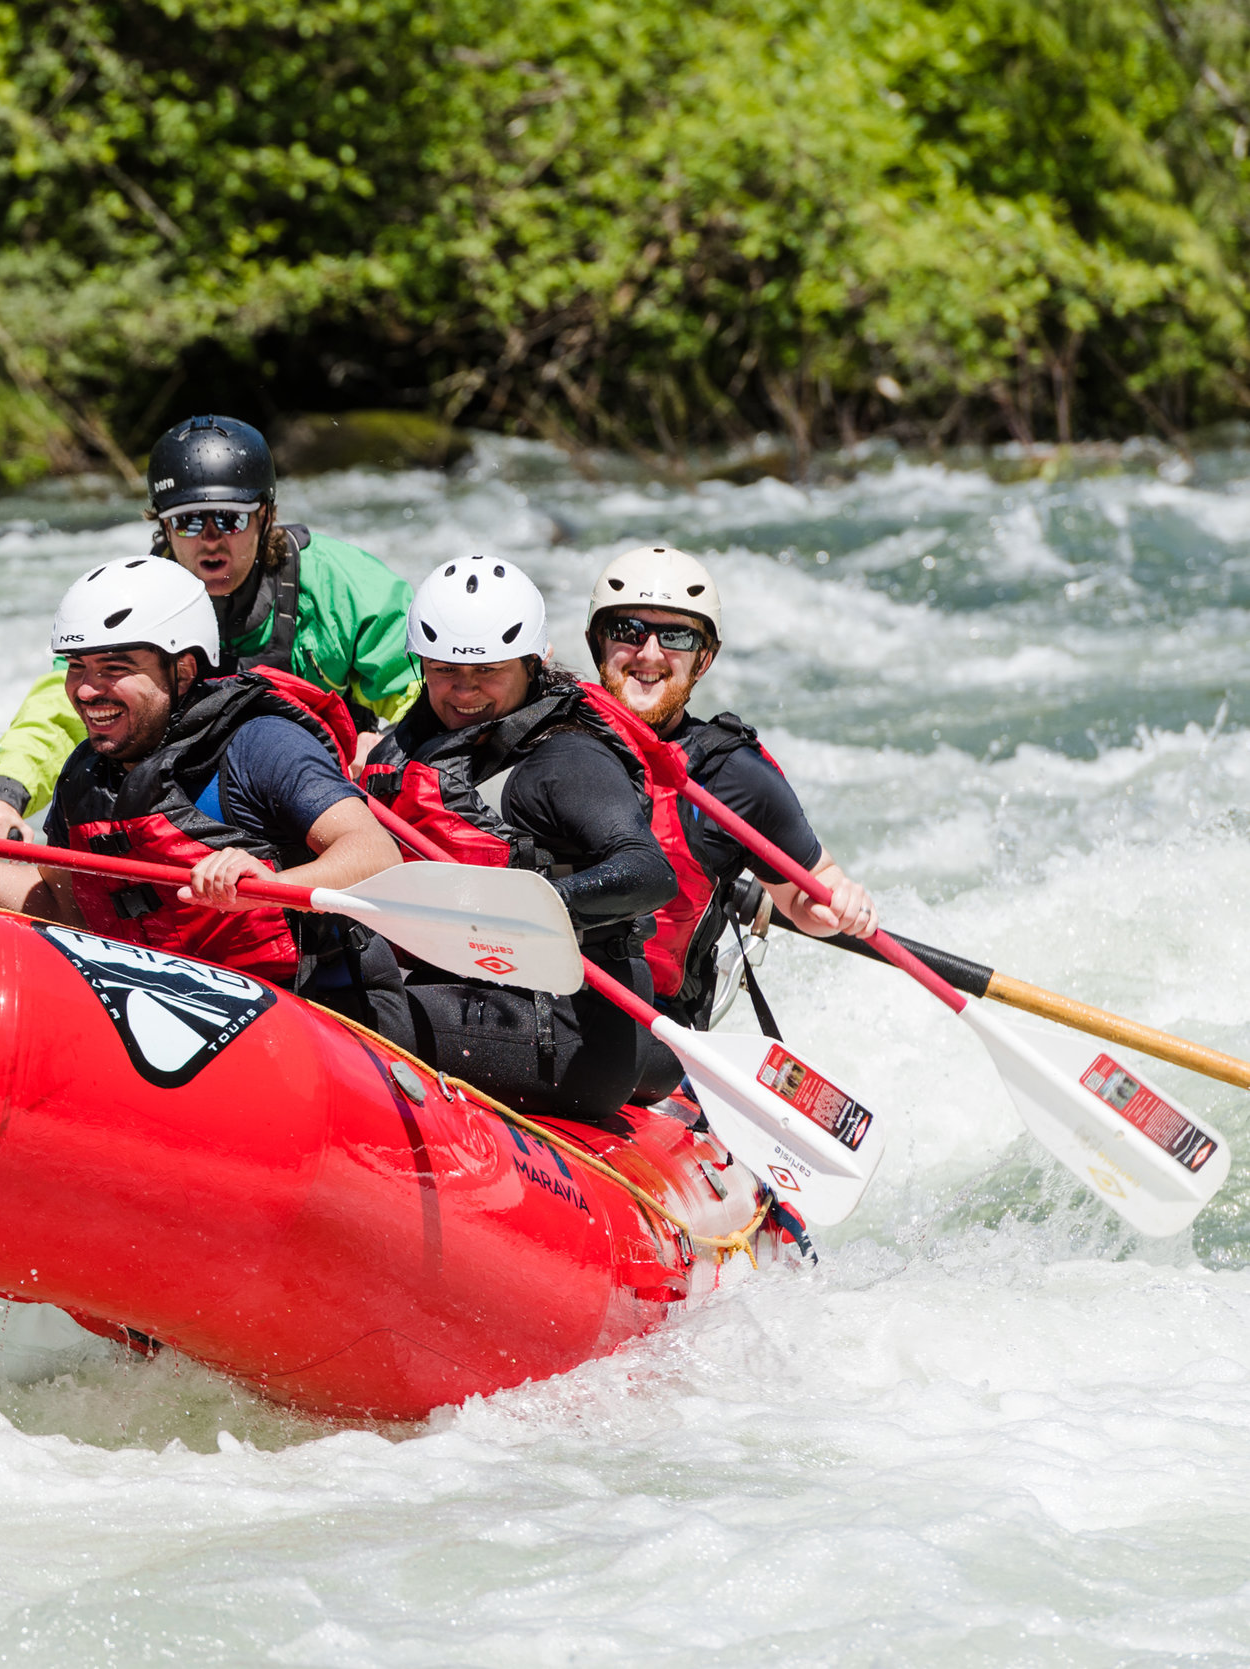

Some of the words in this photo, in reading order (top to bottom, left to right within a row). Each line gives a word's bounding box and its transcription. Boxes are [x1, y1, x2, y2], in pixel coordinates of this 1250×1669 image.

[639, 591, 672, 600] NS
[59, 634, 85, 643] NRS
[452, 646, 486, 655] NRS
[53, 926, 252, 990] TRIAD
[468, 941, 514, 955] carlisle
[71, 957, 122, 1021] RIVER
[207, 1007, 258, 1053] TOURS
[773, 1144, 812, 1179] carlisle
[511, 1152, 592, 1217] MARAVIA
